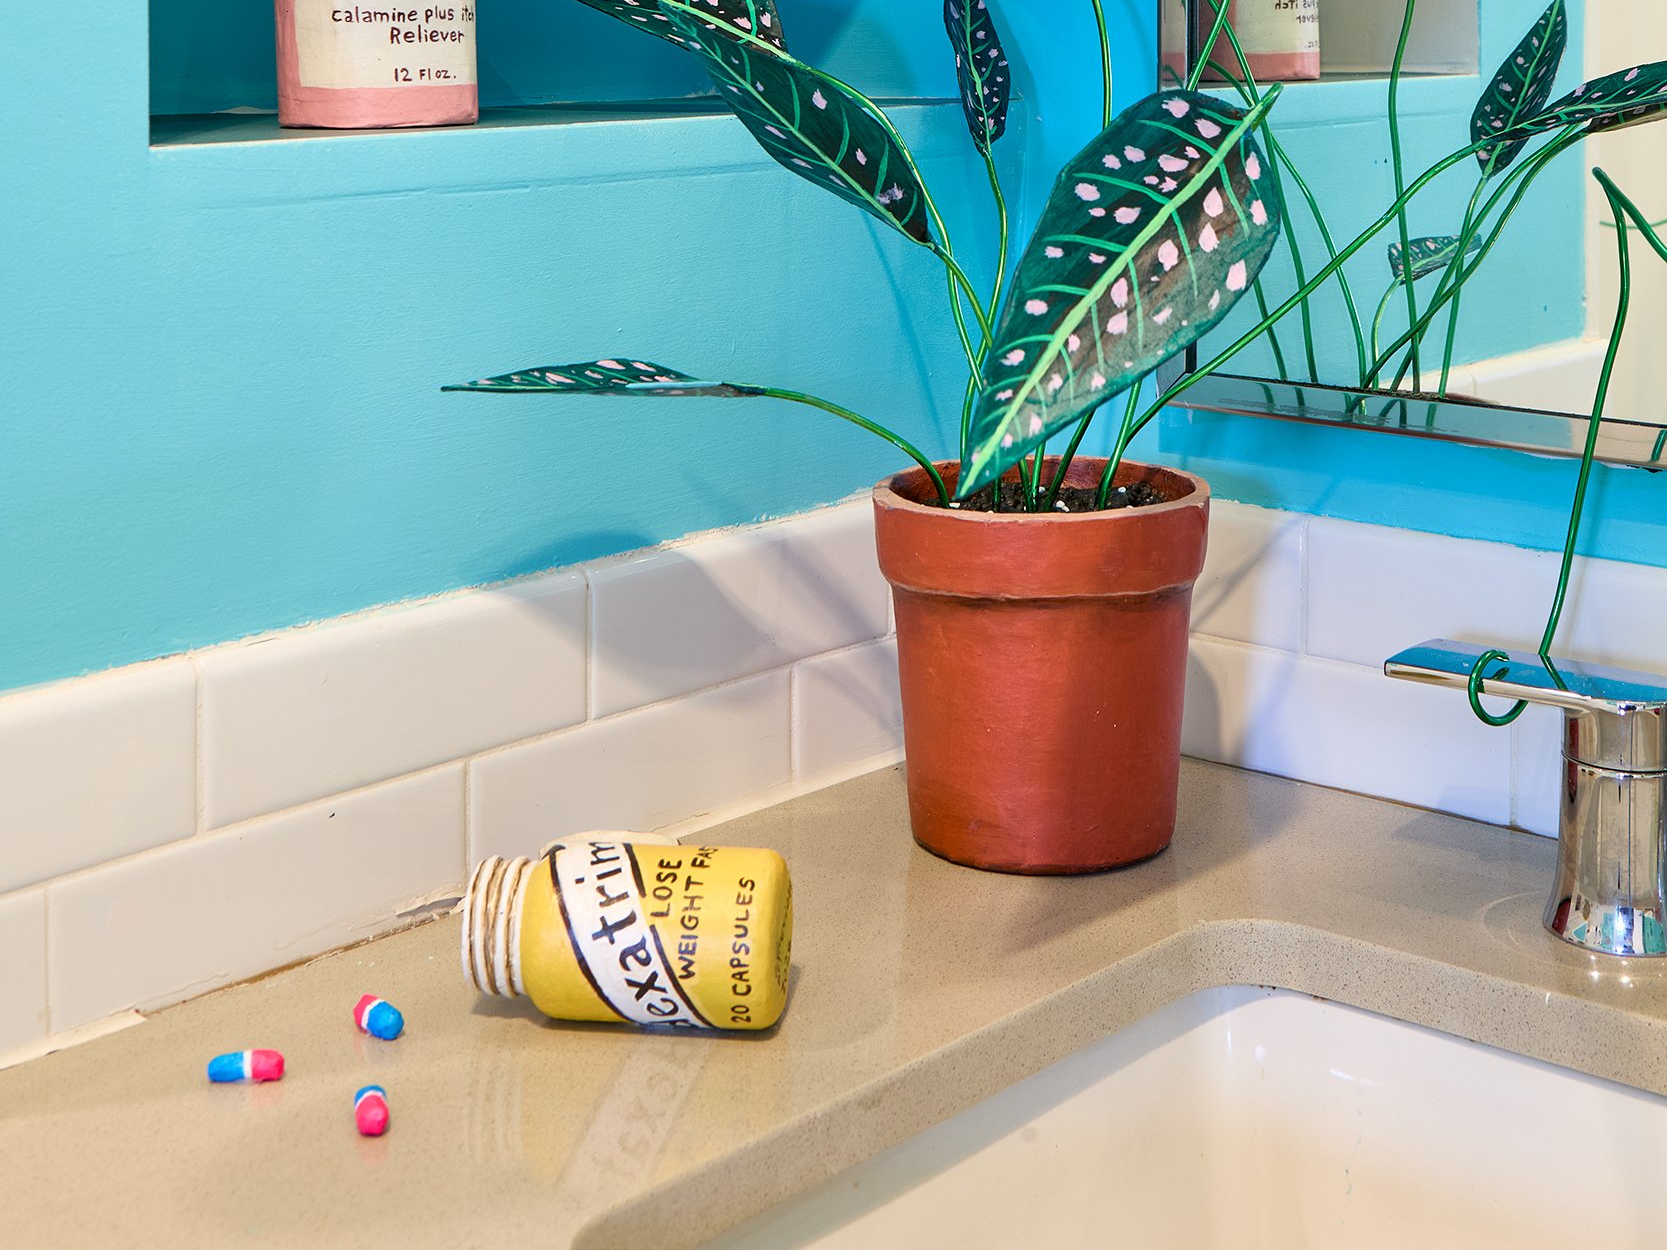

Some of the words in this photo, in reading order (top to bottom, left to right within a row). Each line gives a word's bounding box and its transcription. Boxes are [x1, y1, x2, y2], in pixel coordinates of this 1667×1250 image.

[390, 25, 464, 45] Reliever
[424, 6, 454, 27] plus
[394, 68, 412, 82] 12
[650, 859, 682, 918] LOSE
[575, 842, 690, 1026] exatrim
[678, 875, 703, 980] WEIGHT
[729, 878, 755, 996] CAPSULES
[731, 1004, 751, 1024] 20
